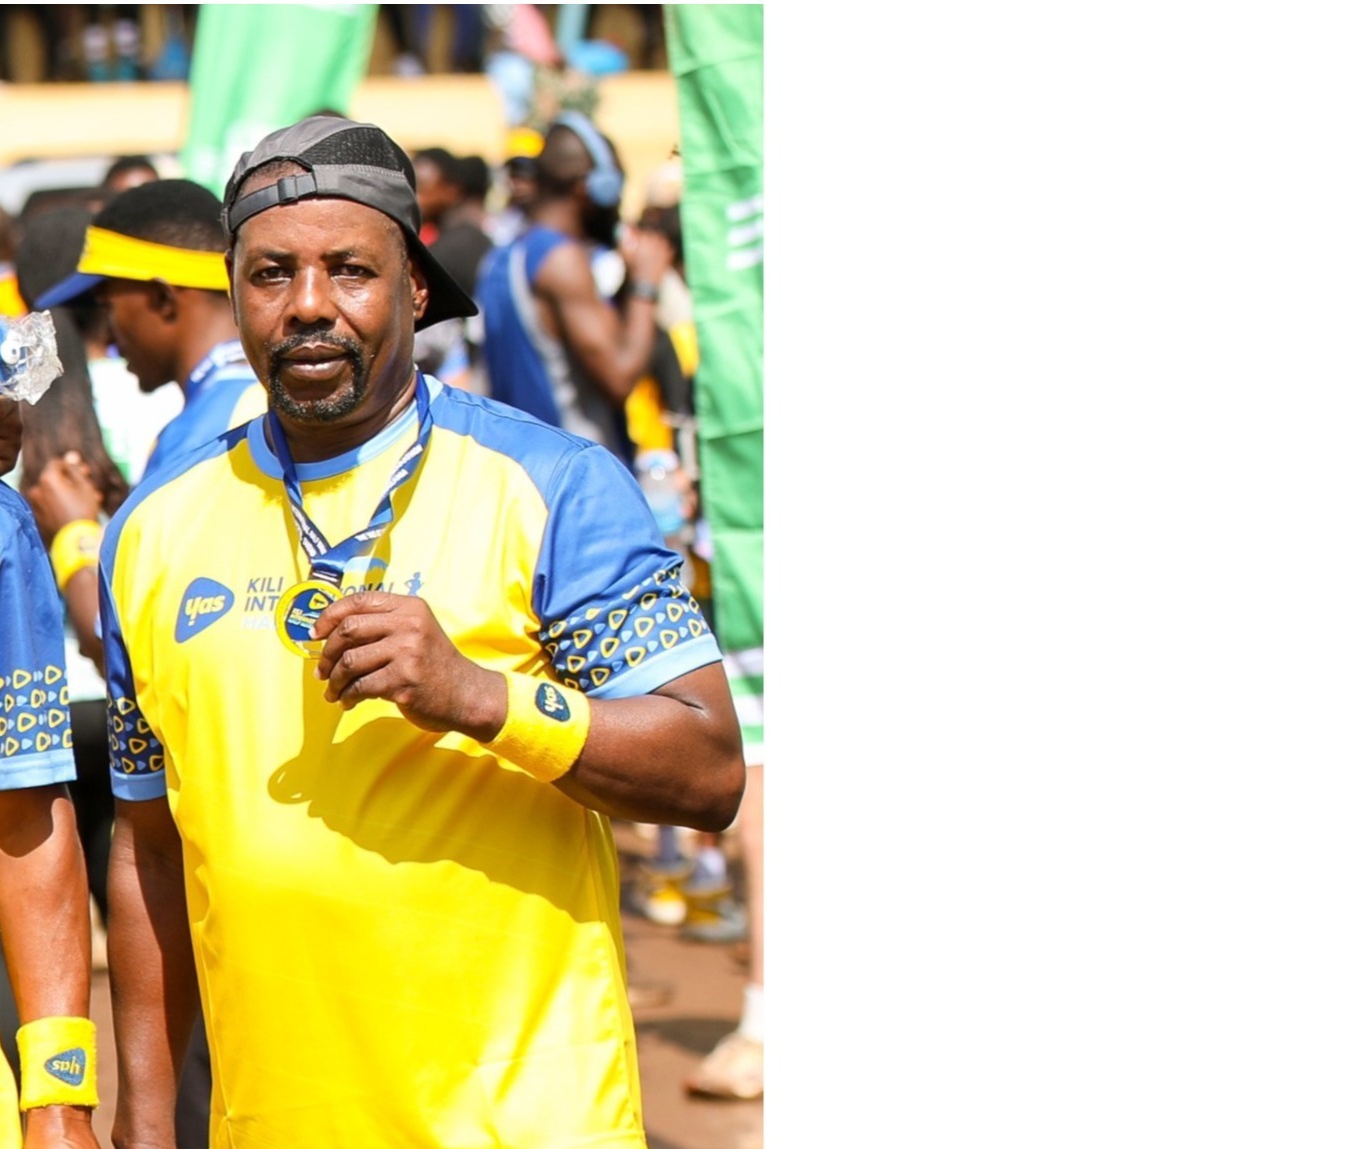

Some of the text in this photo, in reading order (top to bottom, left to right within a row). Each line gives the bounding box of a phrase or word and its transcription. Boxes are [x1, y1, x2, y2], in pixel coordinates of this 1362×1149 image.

[247, 577, 284, 593] KILI
[184, 594, 225, 627] yas
[543, 685, 564, 713] yas
[51, 1054, 81, 1075] yas
